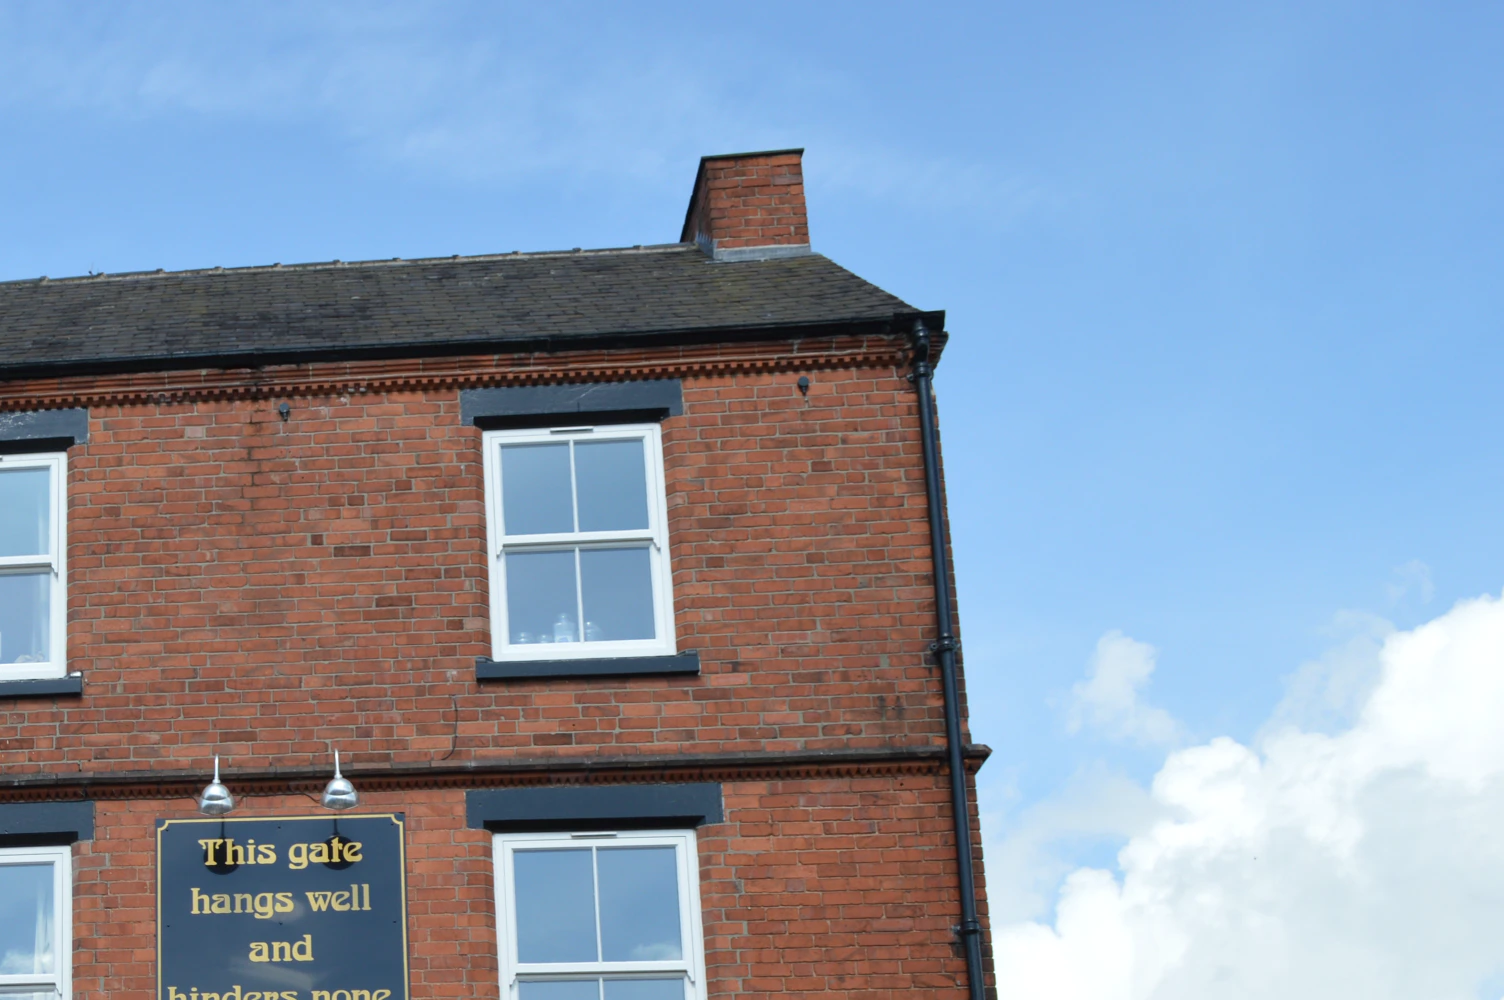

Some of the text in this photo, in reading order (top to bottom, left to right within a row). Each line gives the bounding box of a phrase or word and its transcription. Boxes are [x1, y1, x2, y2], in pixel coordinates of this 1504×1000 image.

[199, 837, 362, 869] This gate
[192, 884, 370, 919] hangs well
[250, 934, 313, 962] and
